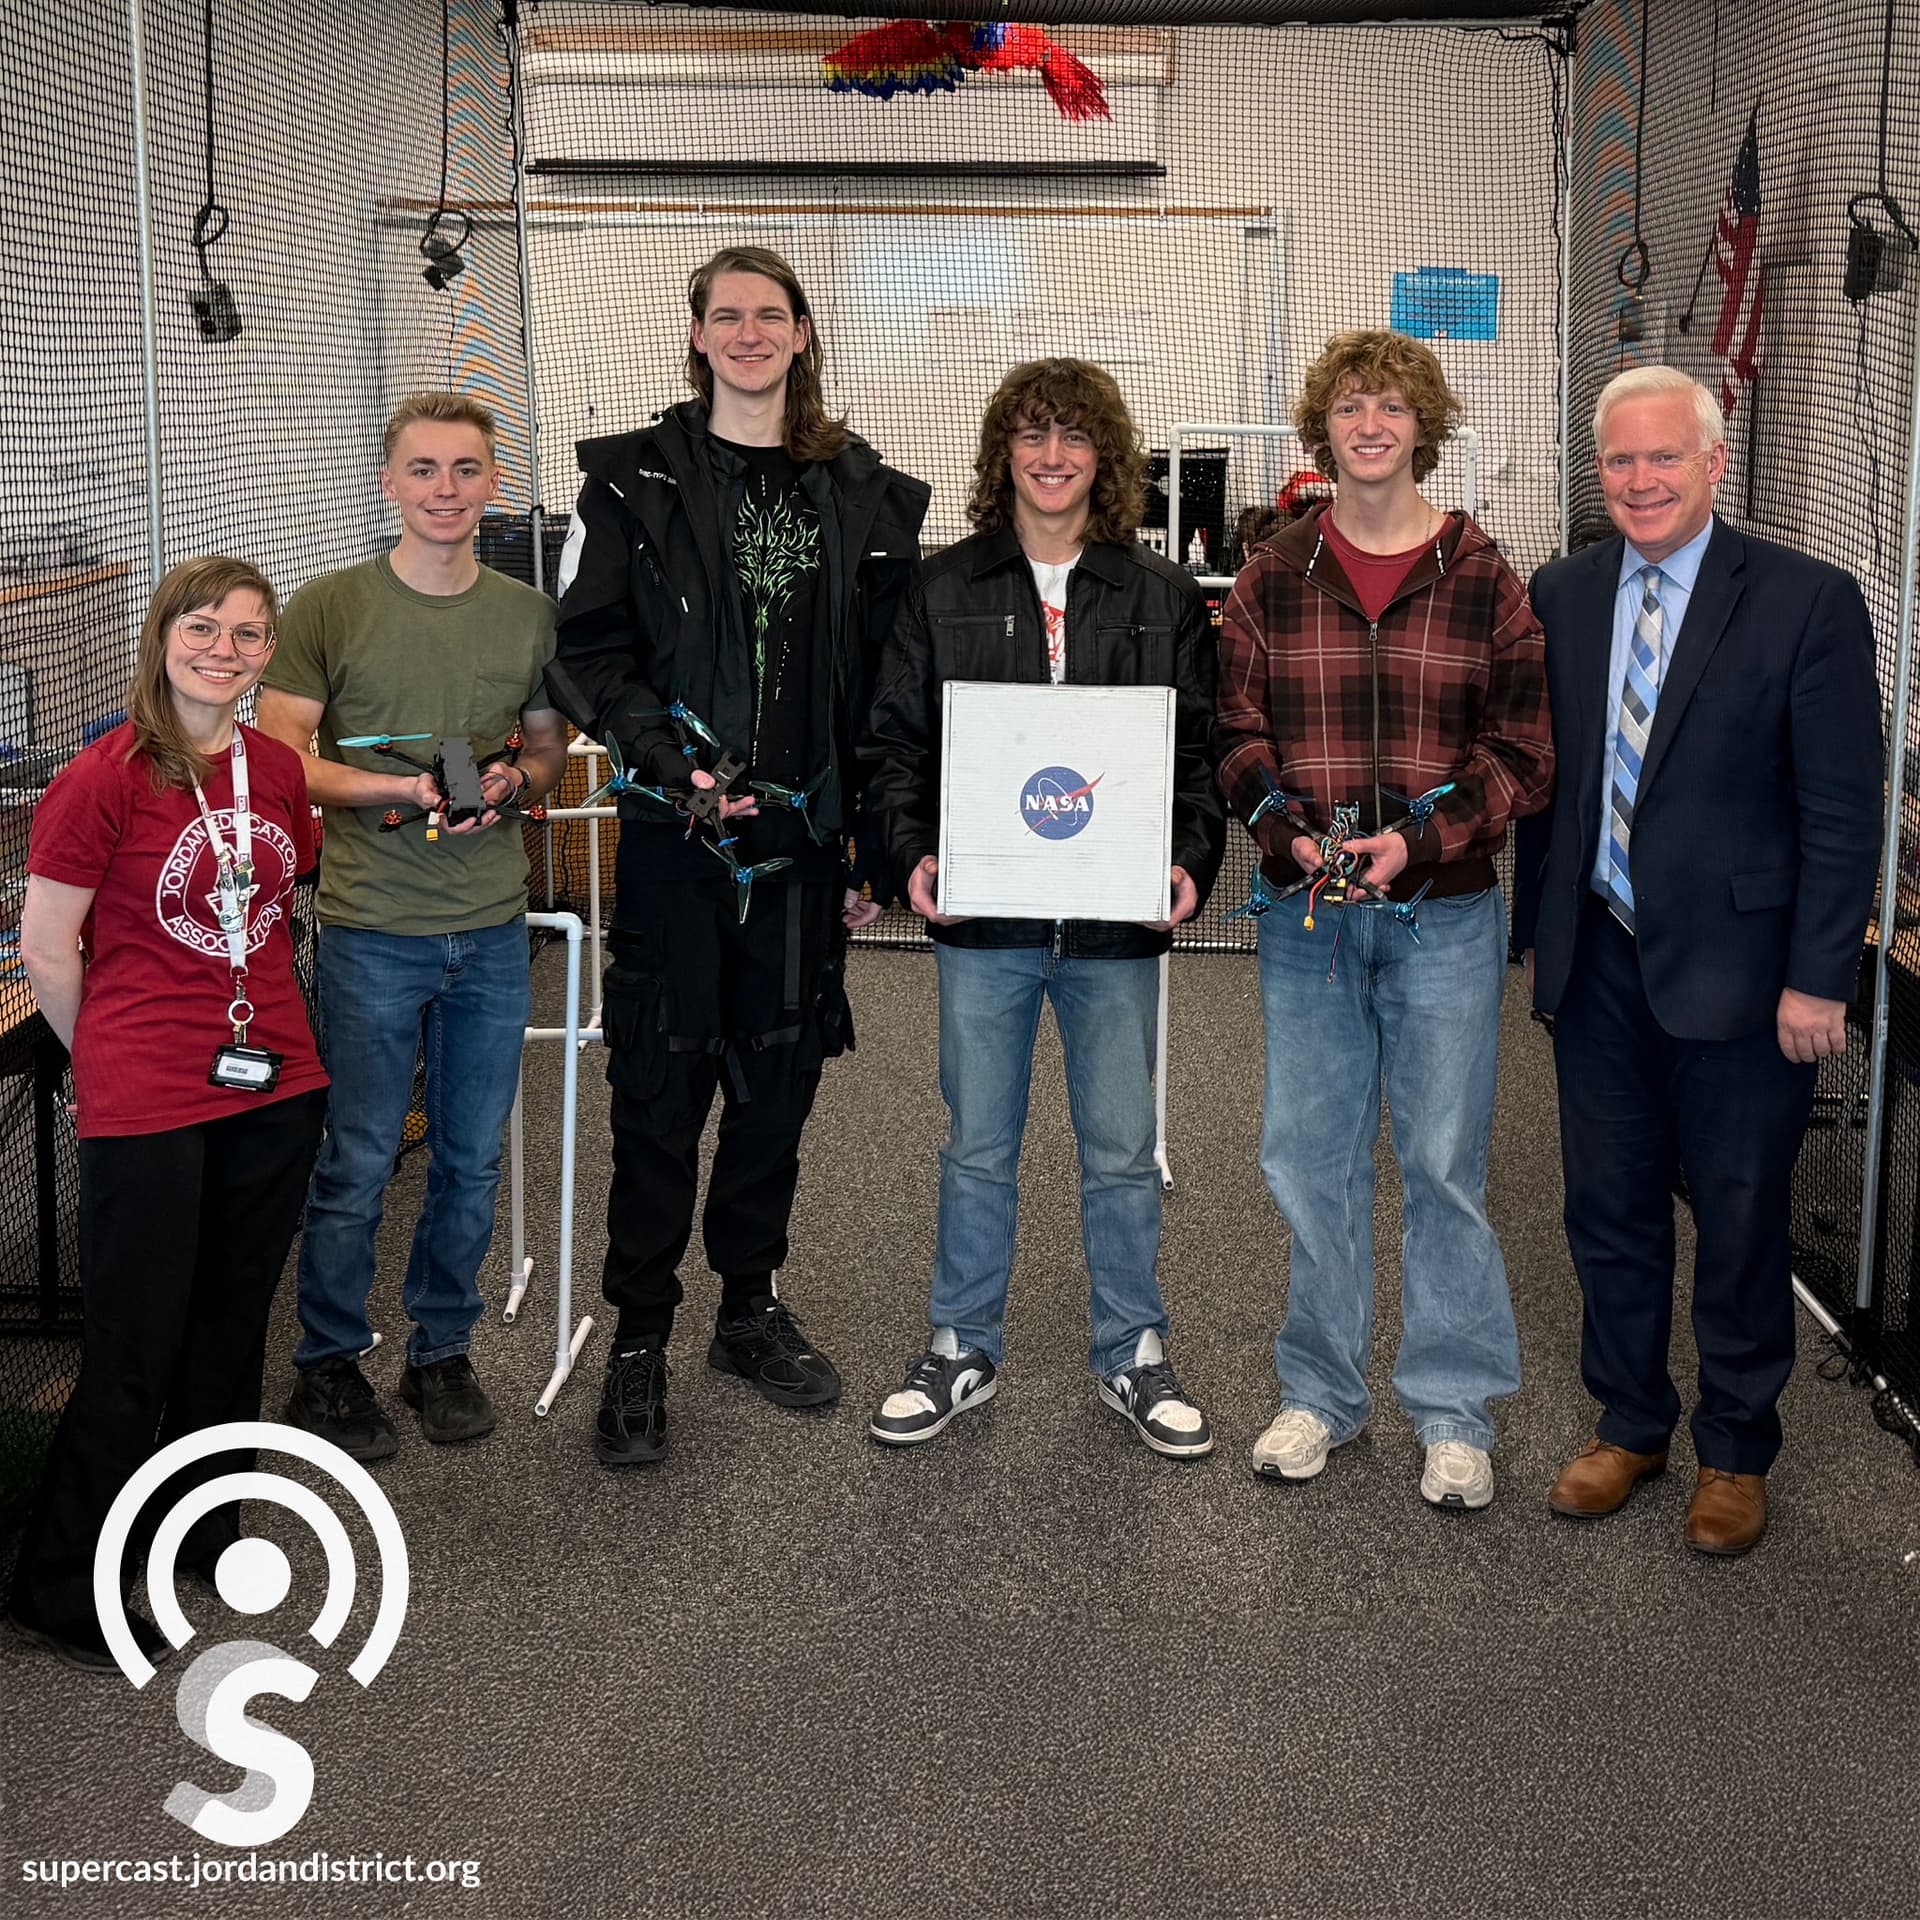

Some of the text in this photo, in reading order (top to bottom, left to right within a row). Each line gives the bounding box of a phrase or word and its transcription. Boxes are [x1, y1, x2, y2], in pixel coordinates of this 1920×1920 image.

[1025, 794, 1090, 812] NASA
[163, 824, 208, 898] JORDAN
[167, 903, 283, 952] ASSOCATION
